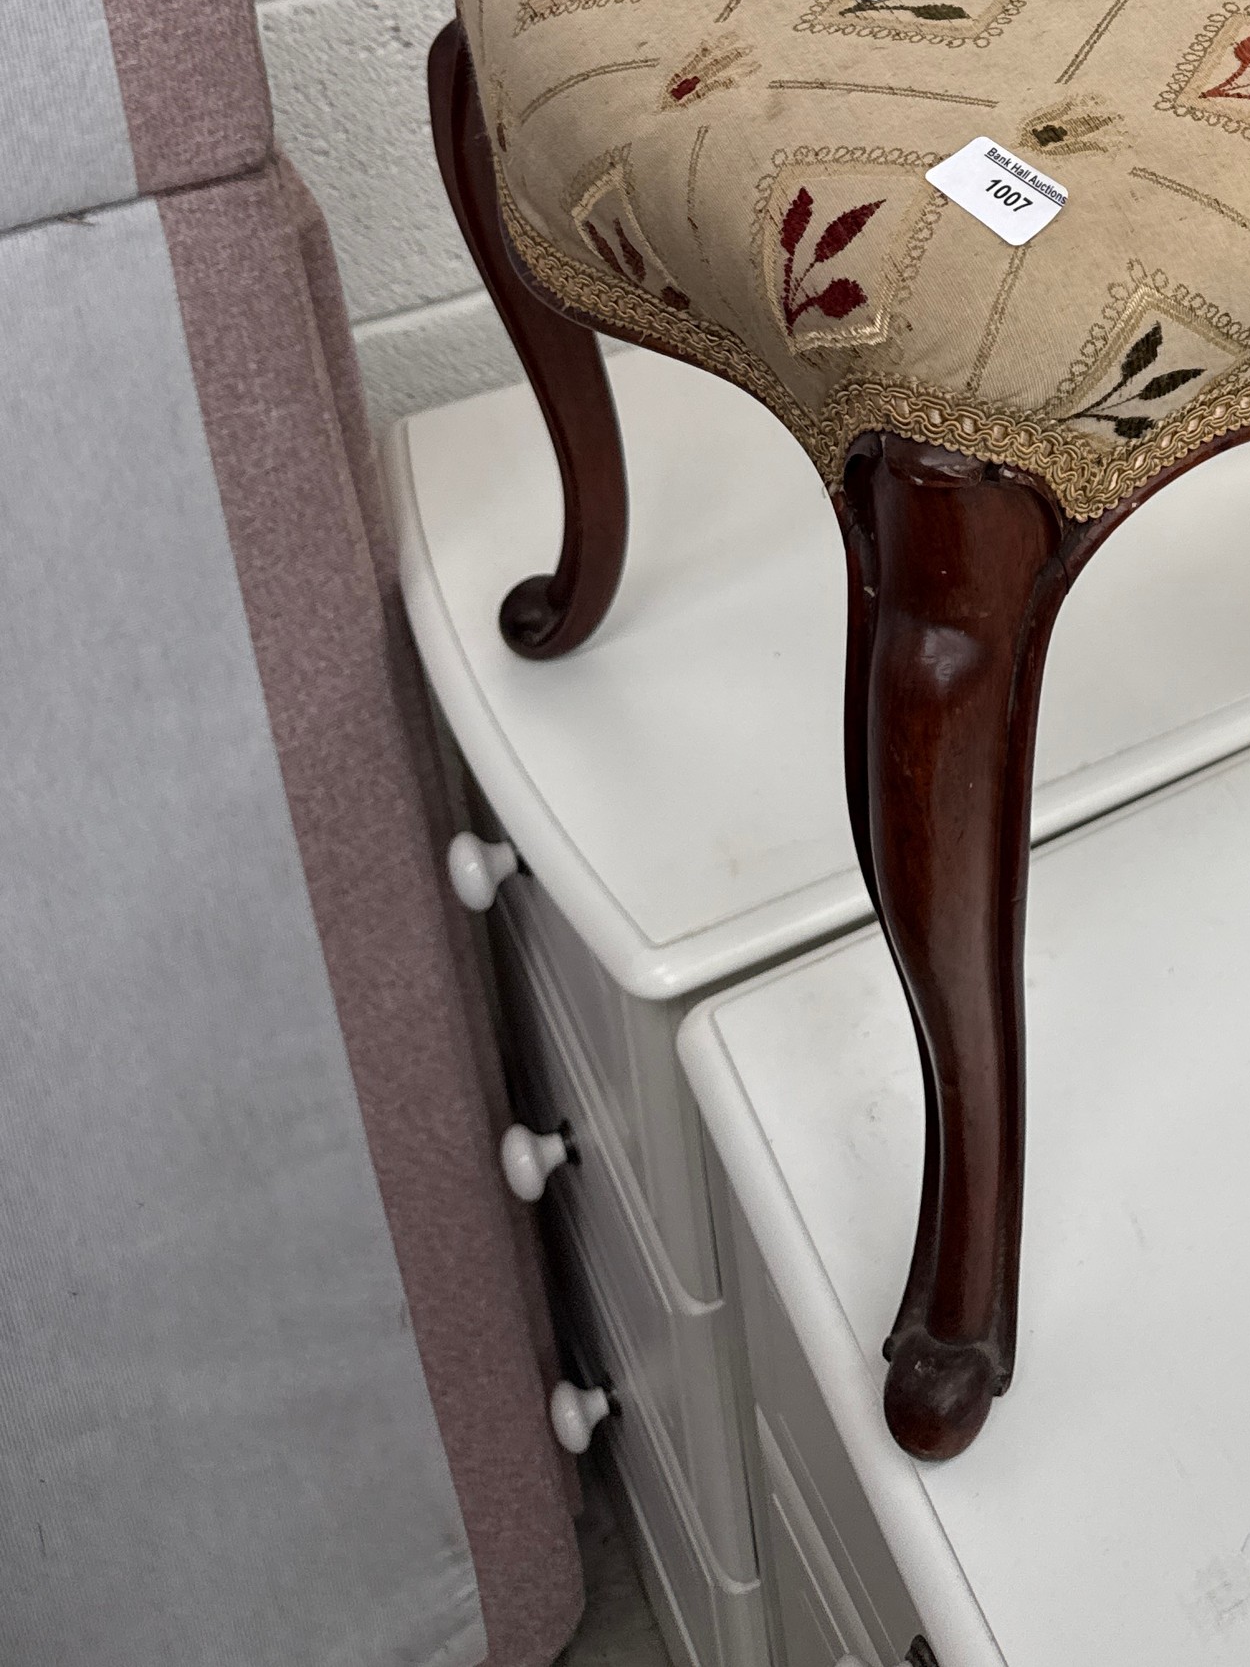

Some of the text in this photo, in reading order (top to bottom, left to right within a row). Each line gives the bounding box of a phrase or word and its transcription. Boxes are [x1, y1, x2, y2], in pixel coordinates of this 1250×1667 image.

[985, 179, 1033, 212] 1007
[986, 147, 1068, 205] Bank Hall Auctions
